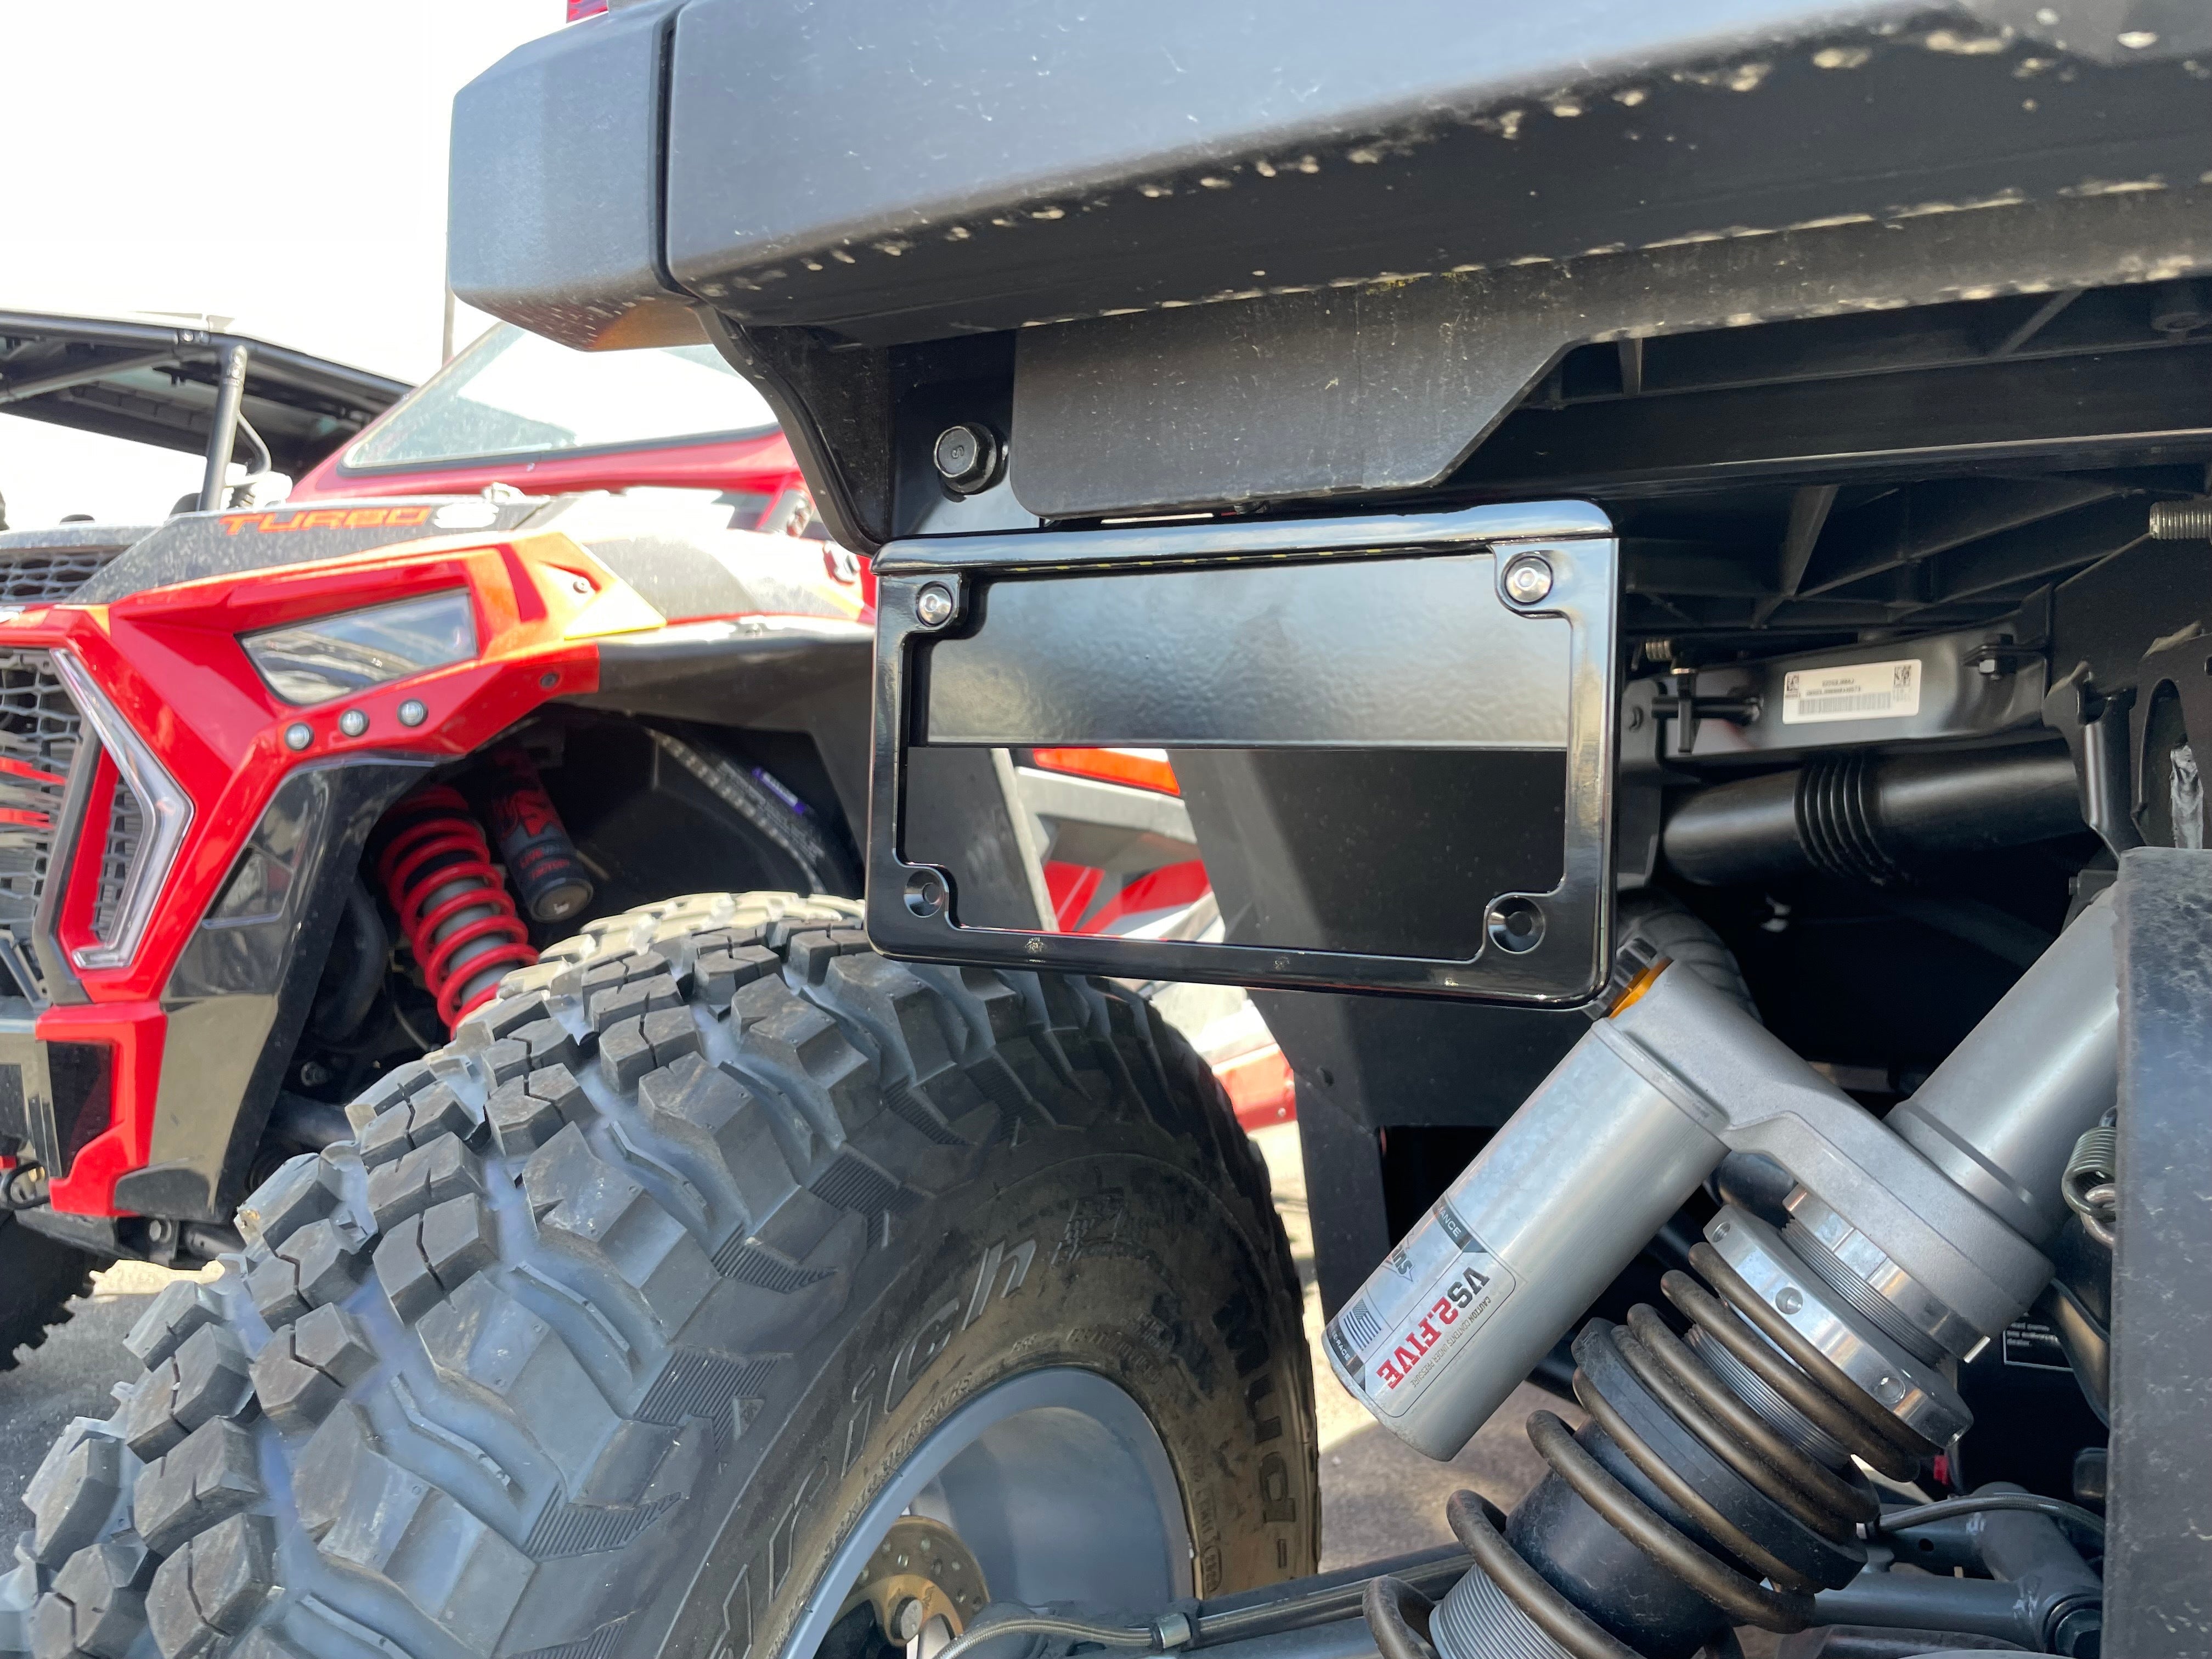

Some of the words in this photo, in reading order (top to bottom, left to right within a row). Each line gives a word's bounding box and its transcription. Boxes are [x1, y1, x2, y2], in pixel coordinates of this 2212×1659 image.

[219, 505, 432, 536] TURBO
[1470, 1296, 1491, 1324] CAUTION
[1375, 1266, 1490, 1390] VS2.FIVE
[1446, 1319, 1471, 1347] CONTENTS
[1433, 1344, 1450, 1363] UNDER
[1410, 1362, 1435, 1388] PRESSURE
